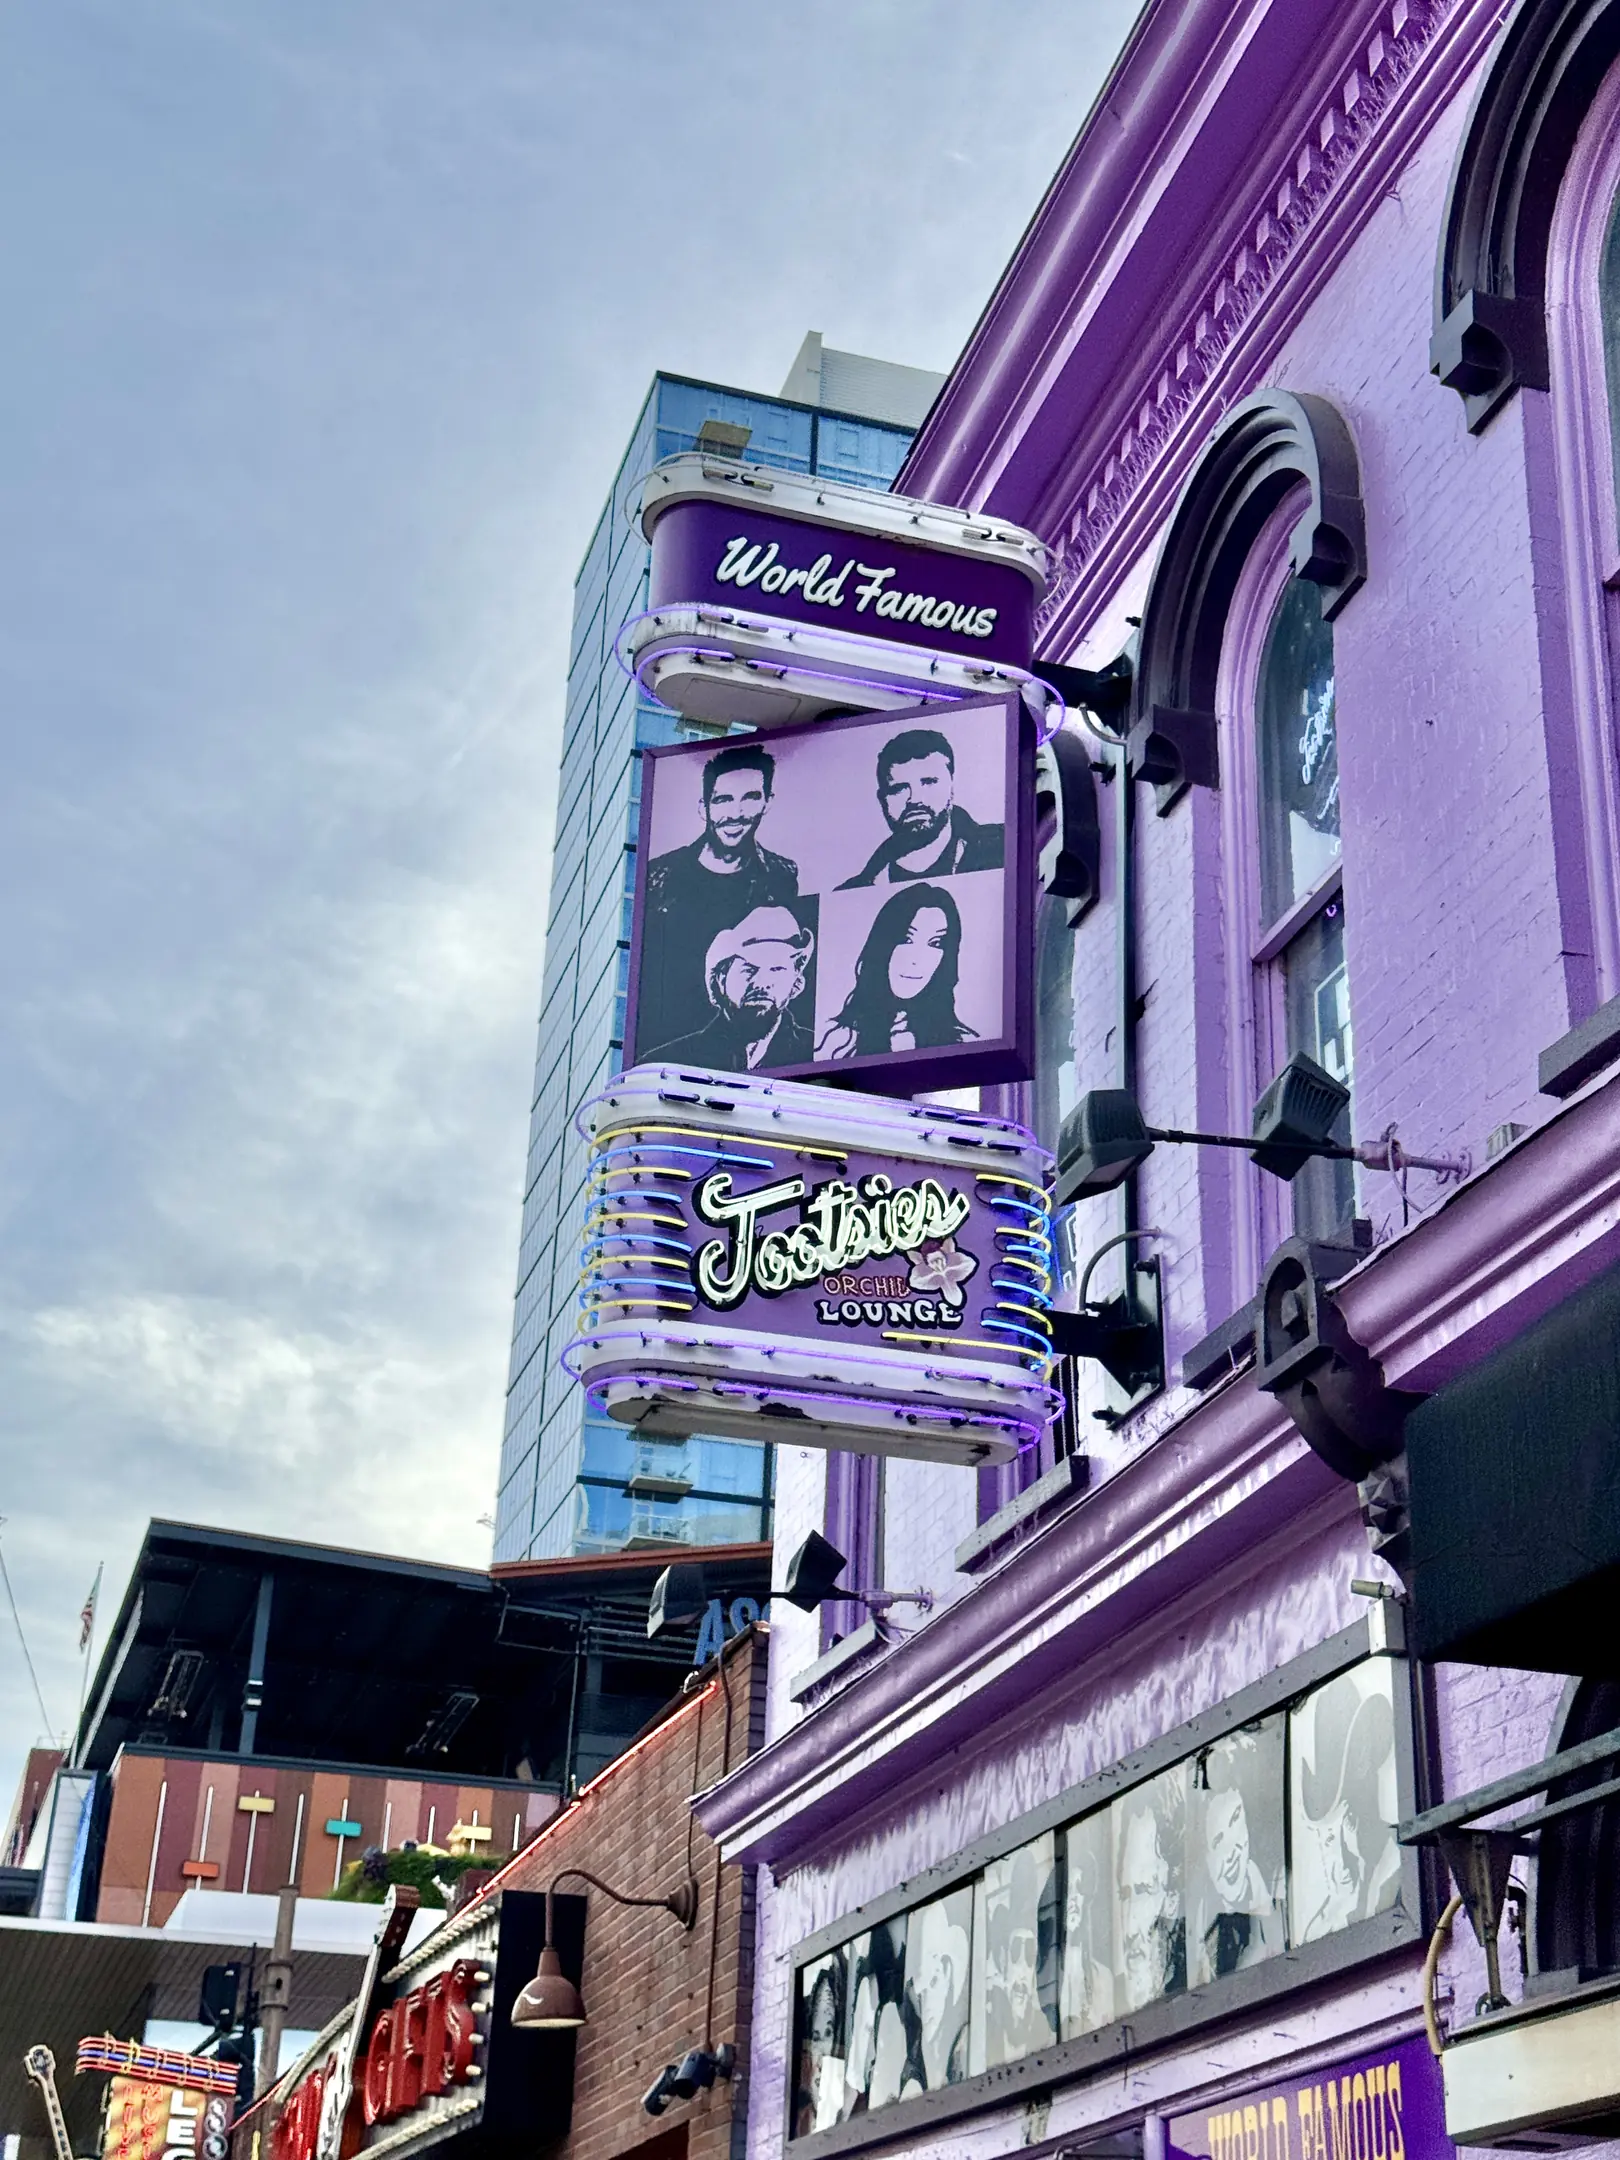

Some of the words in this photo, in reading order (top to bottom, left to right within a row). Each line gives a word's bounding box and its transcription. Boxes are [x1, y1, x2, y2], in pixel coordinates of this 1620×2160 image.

[716, 536, 856, 607] World
[855, 563, 998, 638] Famous
[698, 1172, 971, 1303] Tootsies
[817, 1299, 963, 1326] LOUNGE
[1297, 2060, 1406, 2160] FAMOUS
